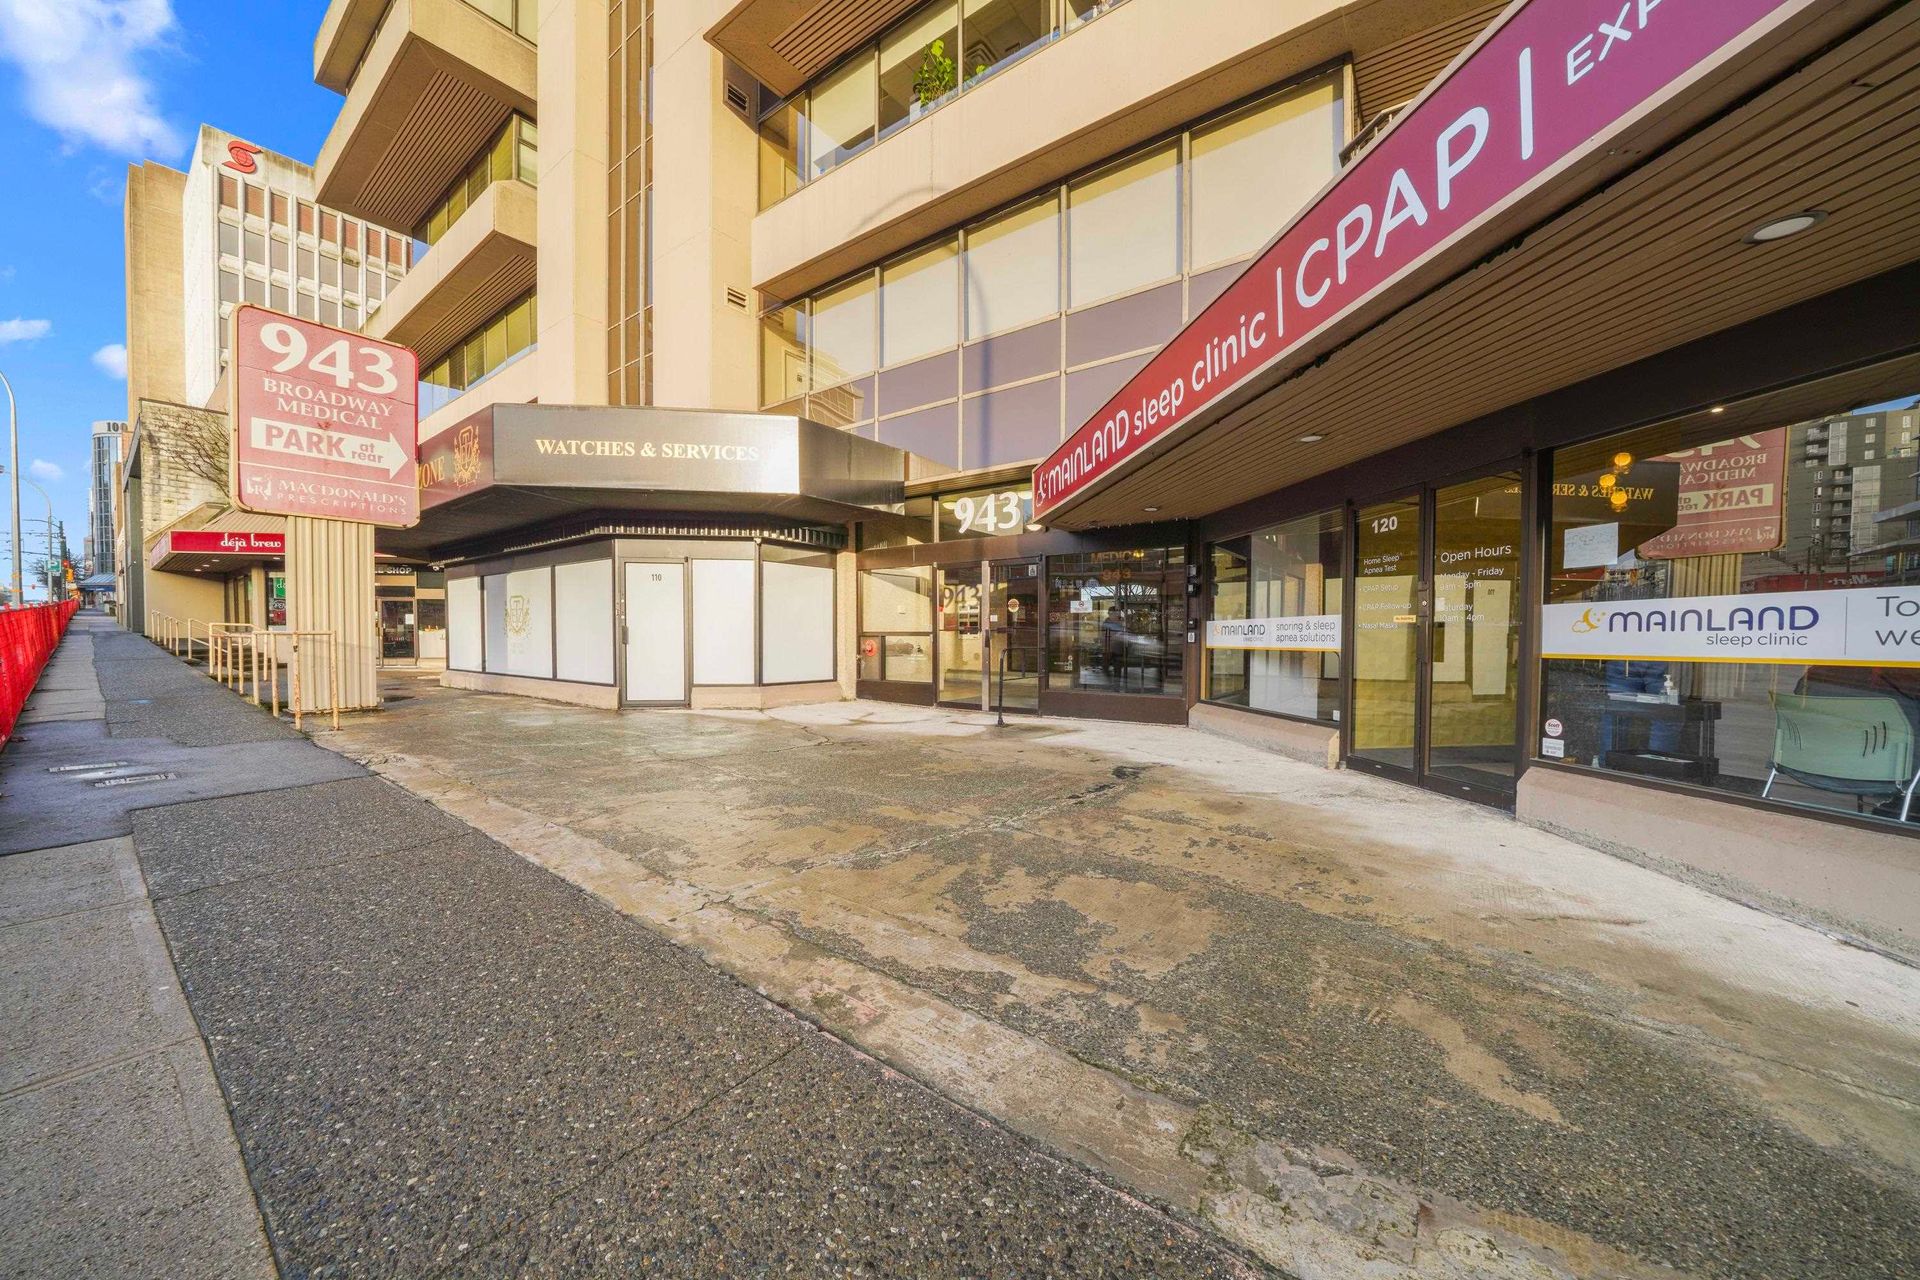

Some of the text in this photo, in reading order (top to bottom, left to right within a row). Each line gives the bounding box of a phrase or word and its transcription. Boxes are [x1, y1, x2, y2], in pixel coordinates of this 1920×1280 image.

[1048, 409, 1130, 499] MAINLAND
[1134, 377, 1185, 436] sleep
[1192, 311, 1266, 392] clinic
[1295, 106, 1489, 308] CPAP
[260, 322, 398, 395] 943
[263, 377, 393, 417] BROADWAY
[277, 397, 383, 431] MEDICAL
[265, 424, 346, 459] PARK
[360, 443, 375, 454] at
[535, 438, 759, 461] WATCHES & SERVICES
[351, 452, 385, 464] rear
[279, 480, 408, 506] MACDONALD'S
[277, 493, 408, 515] PRESCRIPTIONS
[954, 491, 1021, 534] 943
[1371, 516, 1398, 534] 120
[250, 533, 282, 548] brew
[1363, 554, 1400, 565] Home Sleep
[1440, 545, 1512, 564] Open Hours
[651, 573, 662, 582] 110
[1363, 564, 1397, 575] Apnea Test
[1477, 568, 1505, 577] Friday
[1441, 603, 1474, 612] aturday
[1876, 596, 1920, 617] To
[1276, 620, 1336, 633] snoring & sleep
[1466, 613, 1485, 623] 4pm
[1608, 605, 1819, 633] MAINLAND
[1221, 624, 1266, 636] MAINLAND
[1276, 632, 1336, 643] apnea solutions
[1706, 631, 1808, 648] sleep clinic
